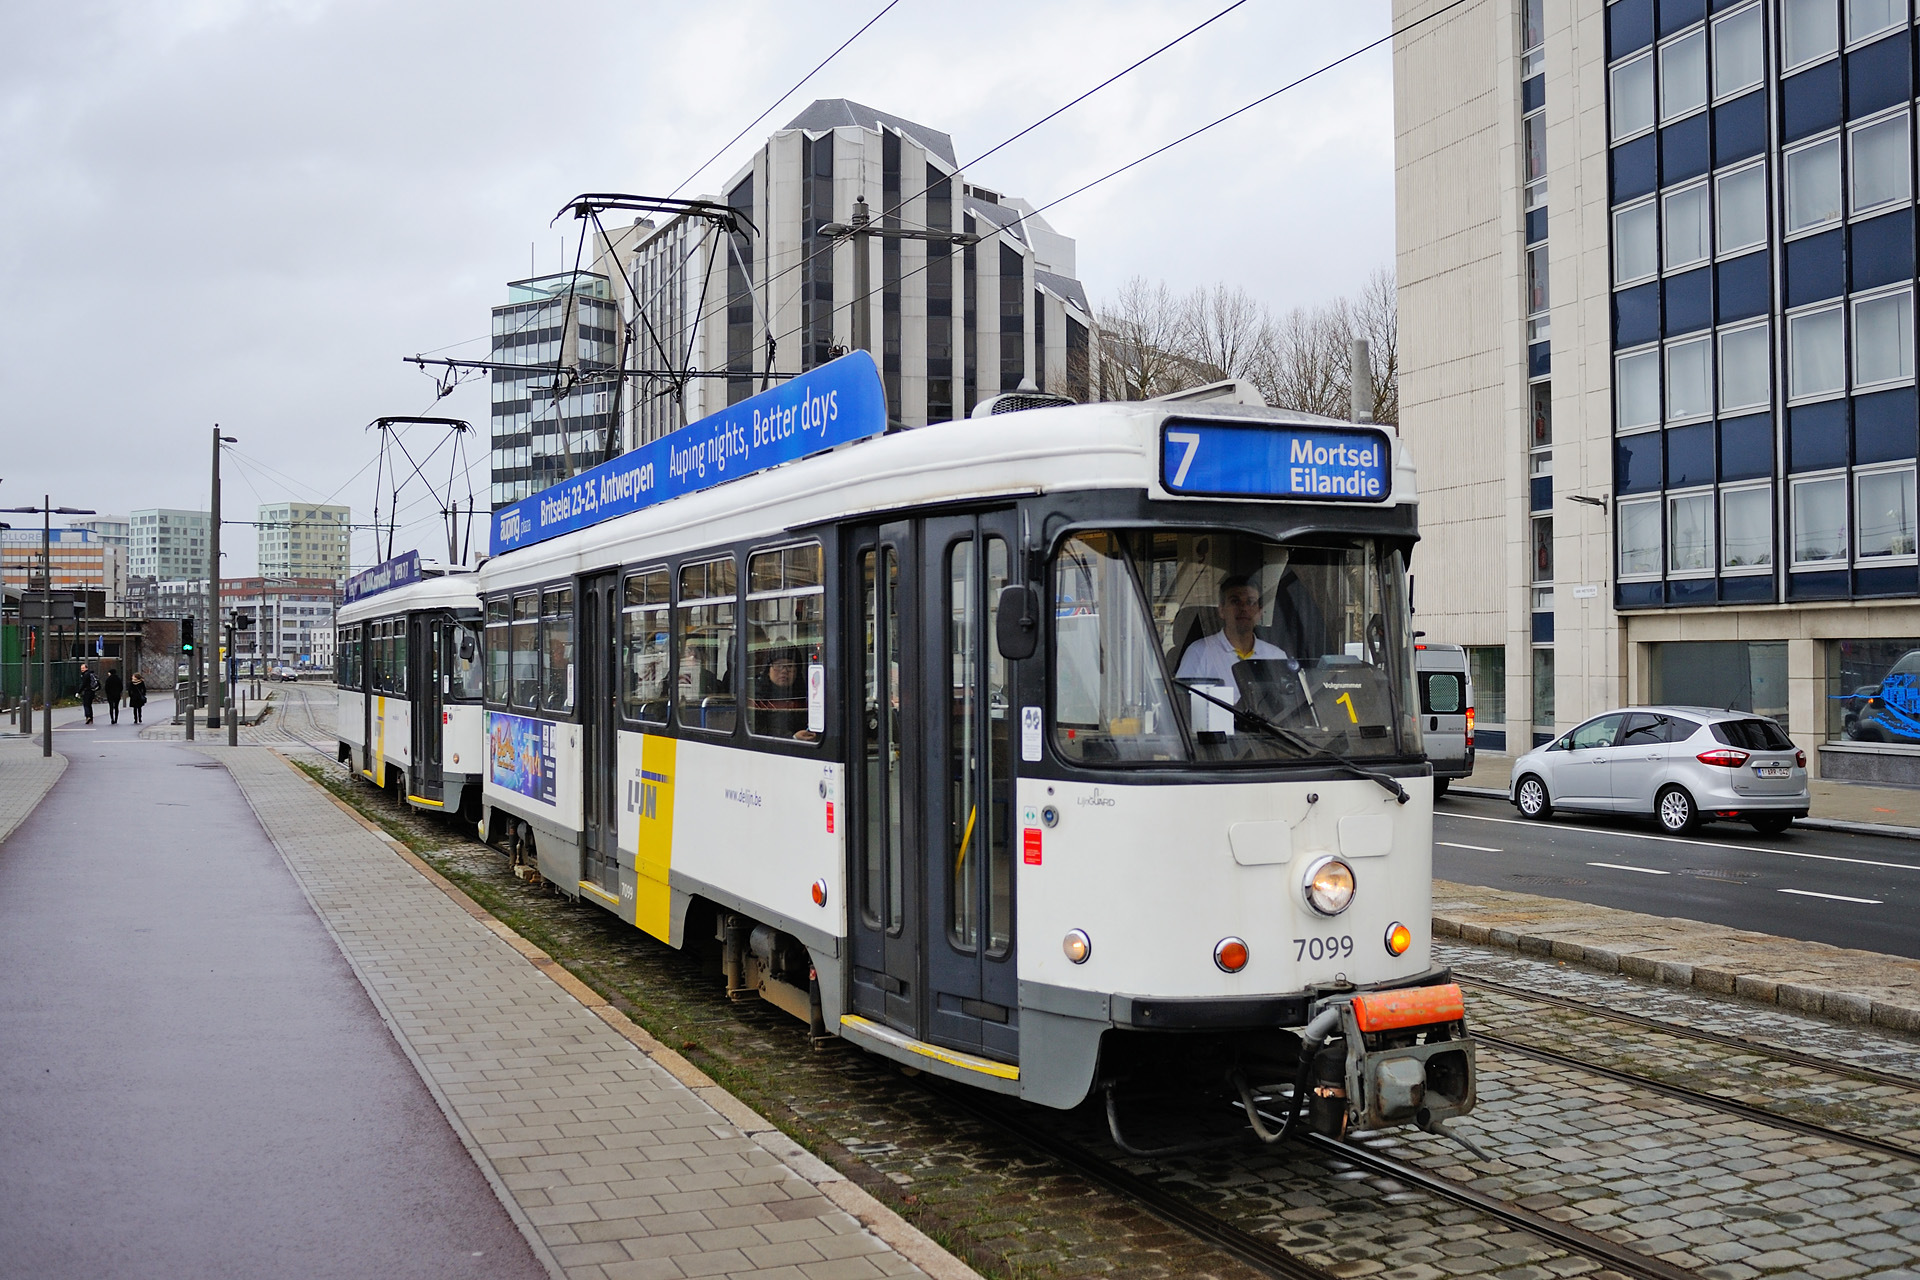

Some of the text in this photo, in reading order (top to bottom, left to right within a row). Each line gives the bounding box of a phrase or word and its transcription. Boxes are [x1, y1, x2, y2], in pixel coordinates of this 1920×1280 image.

[669, 386, 838, 483] Auping nights, Better days
[1167, 432, 1200, 487] 7
[1290, 439, 1379, 468] Mortsel
[540, 462, 654, 527] Britselei 23-25, Antwerpen
[1290, 467, 1380, 497] Eilandje
[500, 509, 520, 545] auping
[1323, 682, 1362, 690] Volgnummer
[1335, 692, 1358, 723] 1
[725, 788, 761, 807] www.delijn.be
[621, 882, 634, 900] 7099
[1293, 935, 1354, 962] 7099
